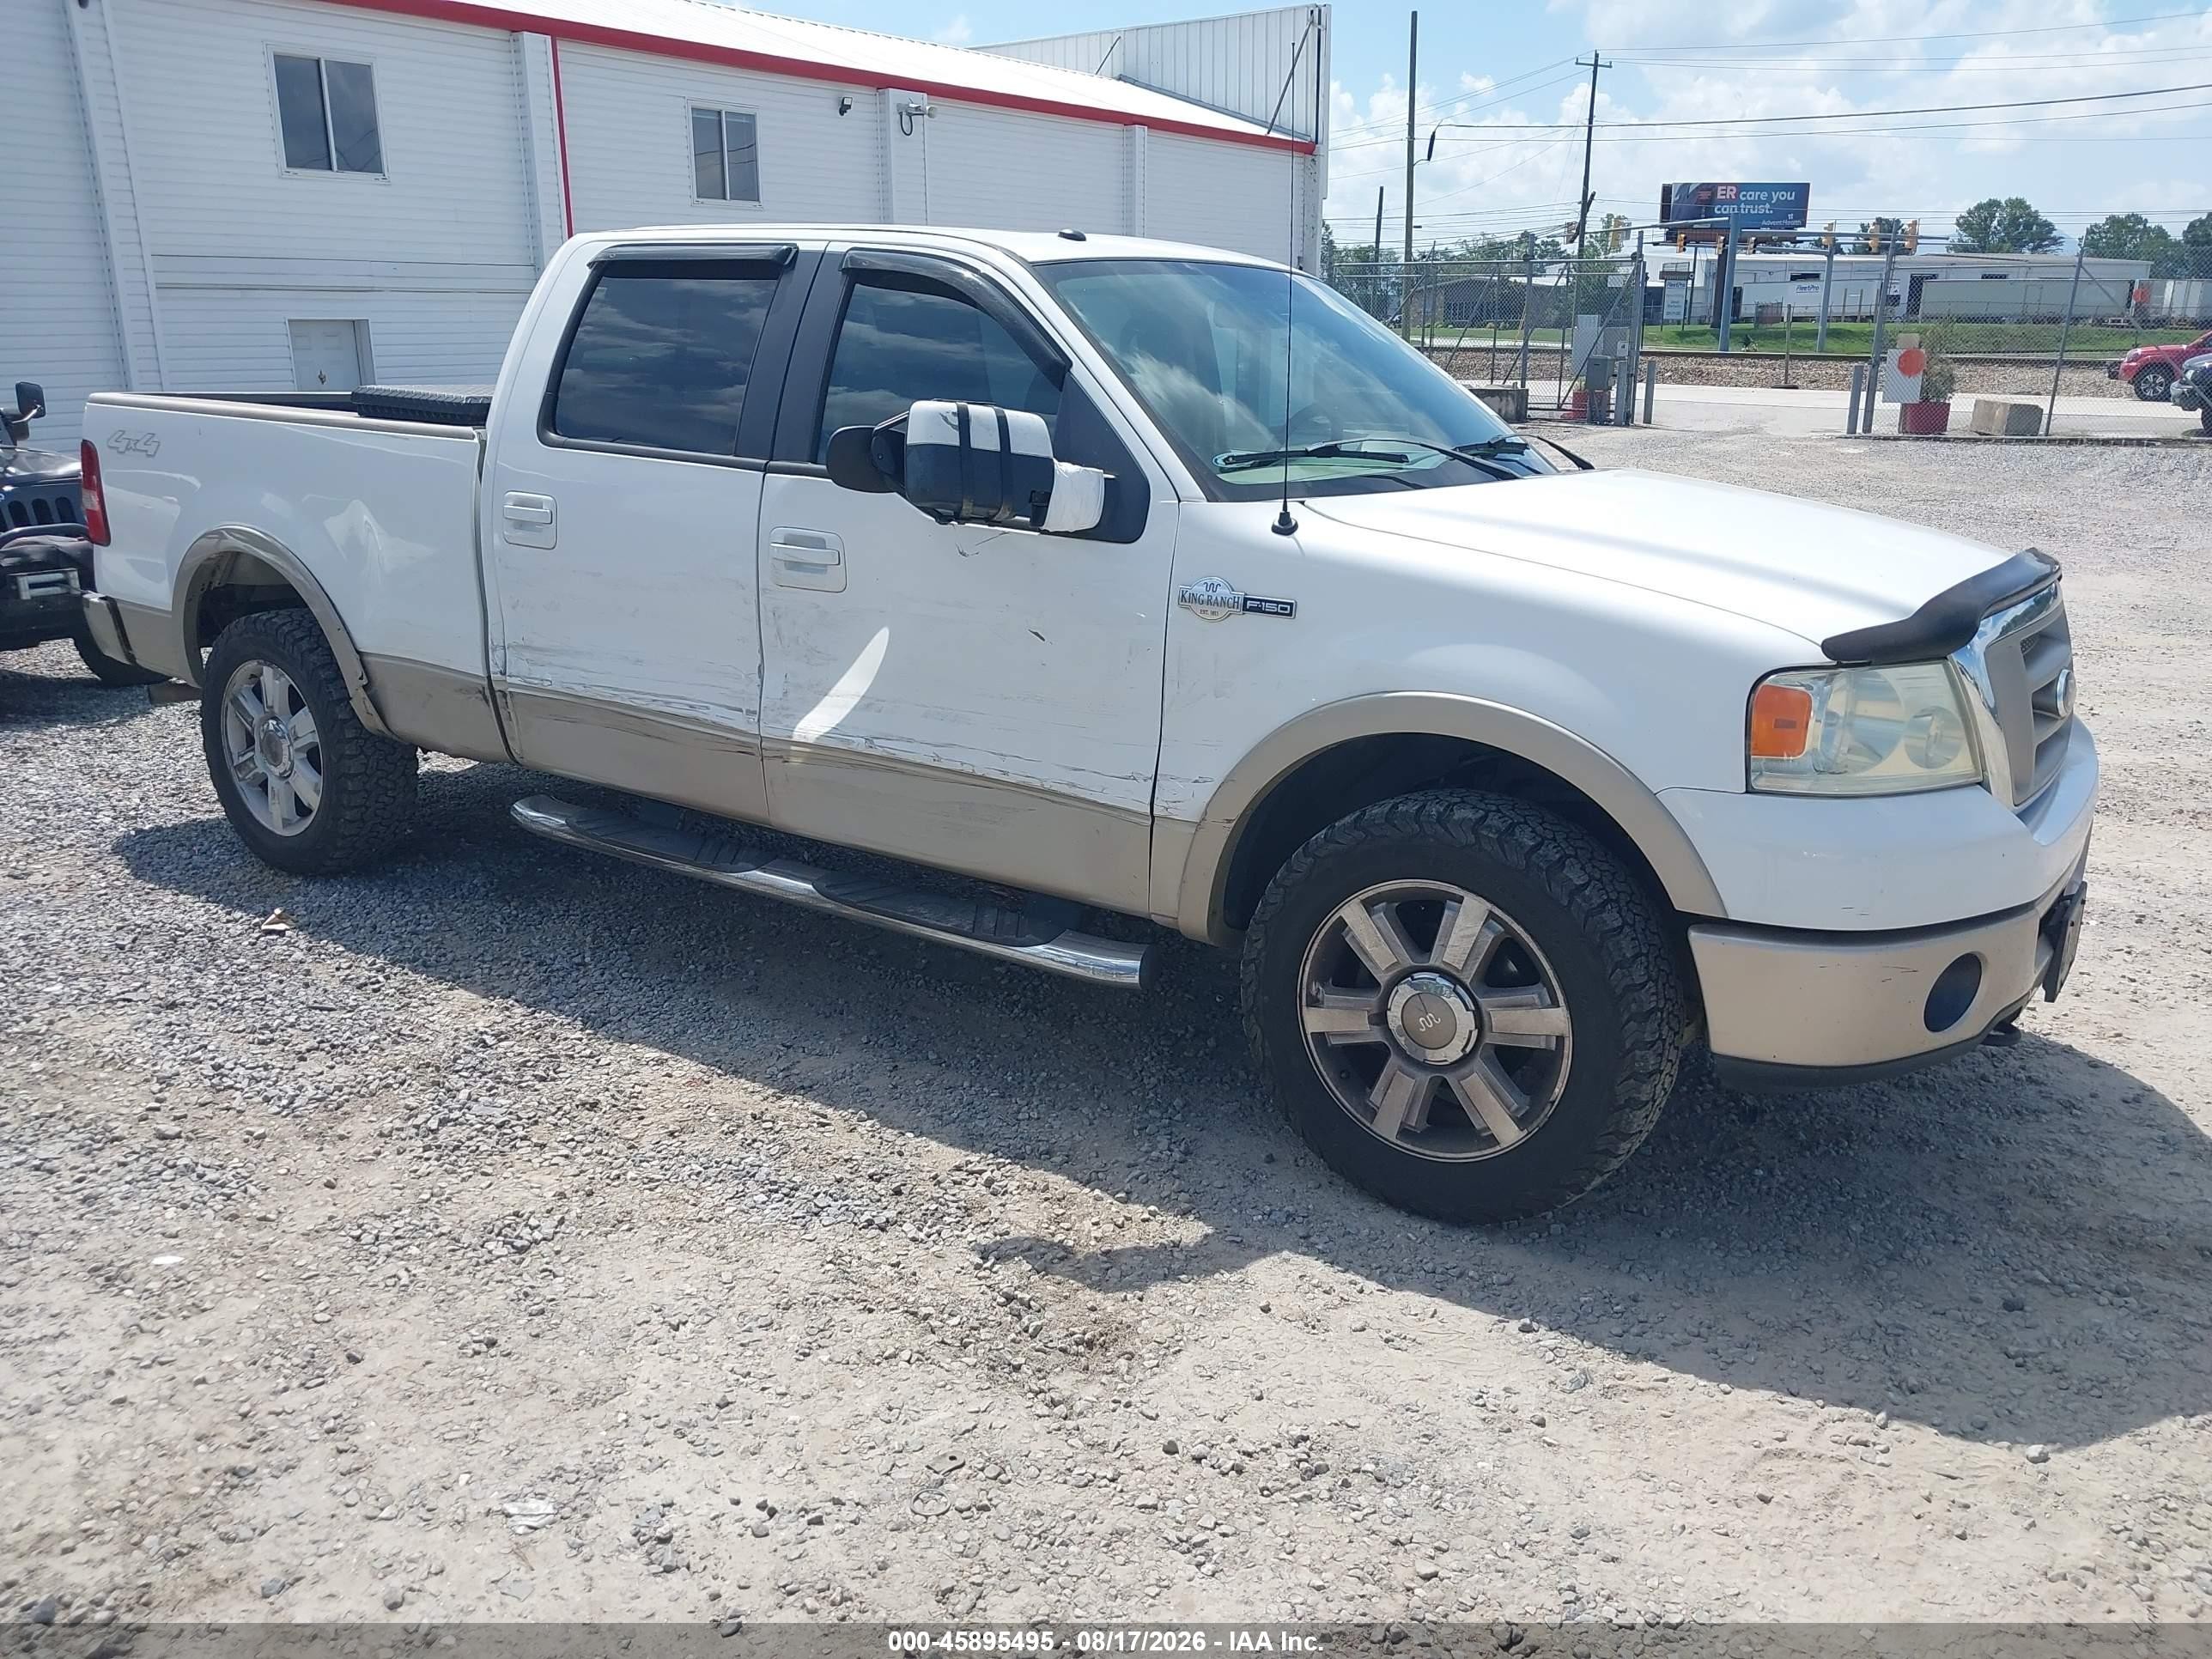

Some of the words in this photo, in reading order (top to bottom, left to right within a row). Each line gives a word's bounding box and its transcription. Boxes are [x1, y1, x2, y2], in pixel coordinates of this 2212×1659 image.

[1717, 185, 1737, 199] ER
[1739, 191, 1768, 201] care
[1771, 191, 1796, 204] you
[1714, 204, 1738, 215] can
[1740, 203, 1773, 215] trust.
[107, 429, 161, 458] 4x4
[1180, 589, 1205, 605] KING
[1206, 594, 1241, 610] RANCH
[1246, 600, 1291, 614] F-150
